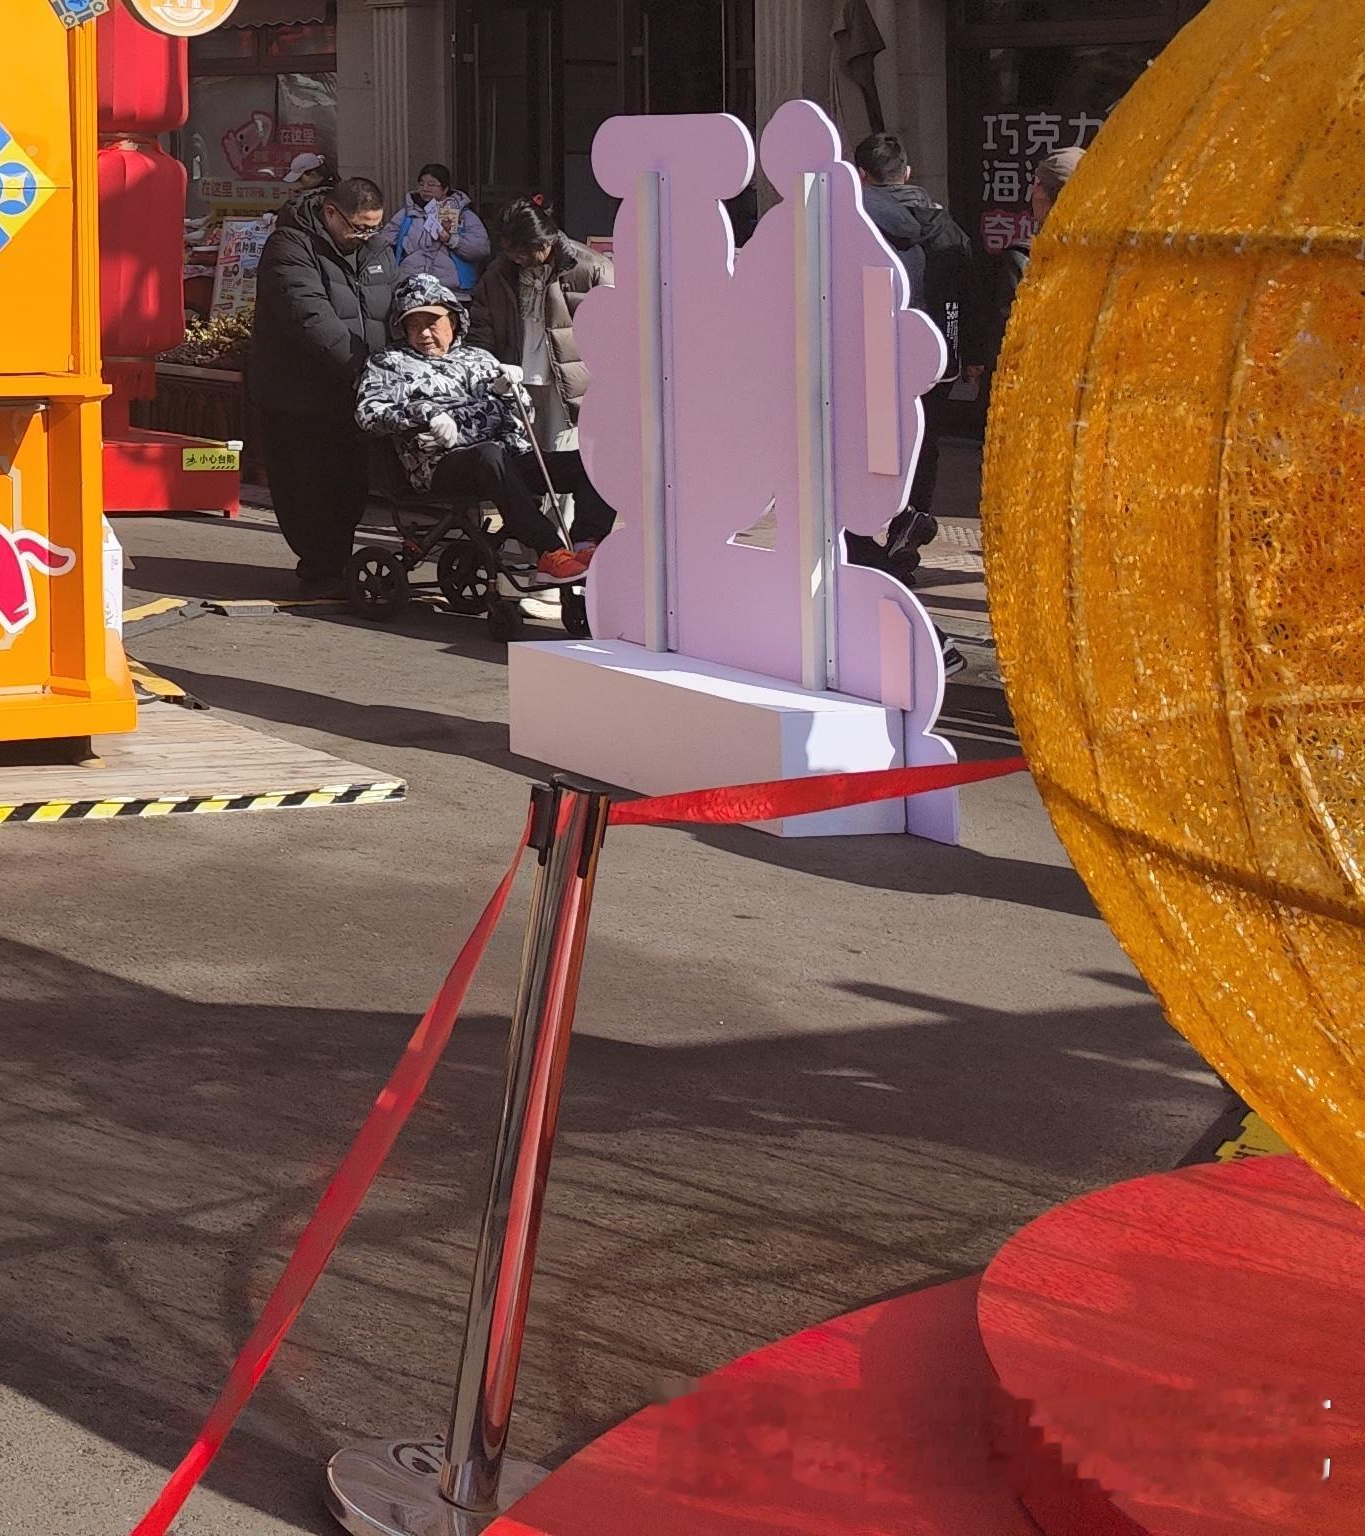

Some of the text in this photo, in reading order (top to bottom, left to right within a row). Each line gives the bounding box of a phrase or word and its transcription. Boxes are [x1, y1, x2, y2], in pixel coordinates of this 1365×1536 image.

[983, 159, 1040, 202] 海
[200, 454, 235, 464] 小心台阶
